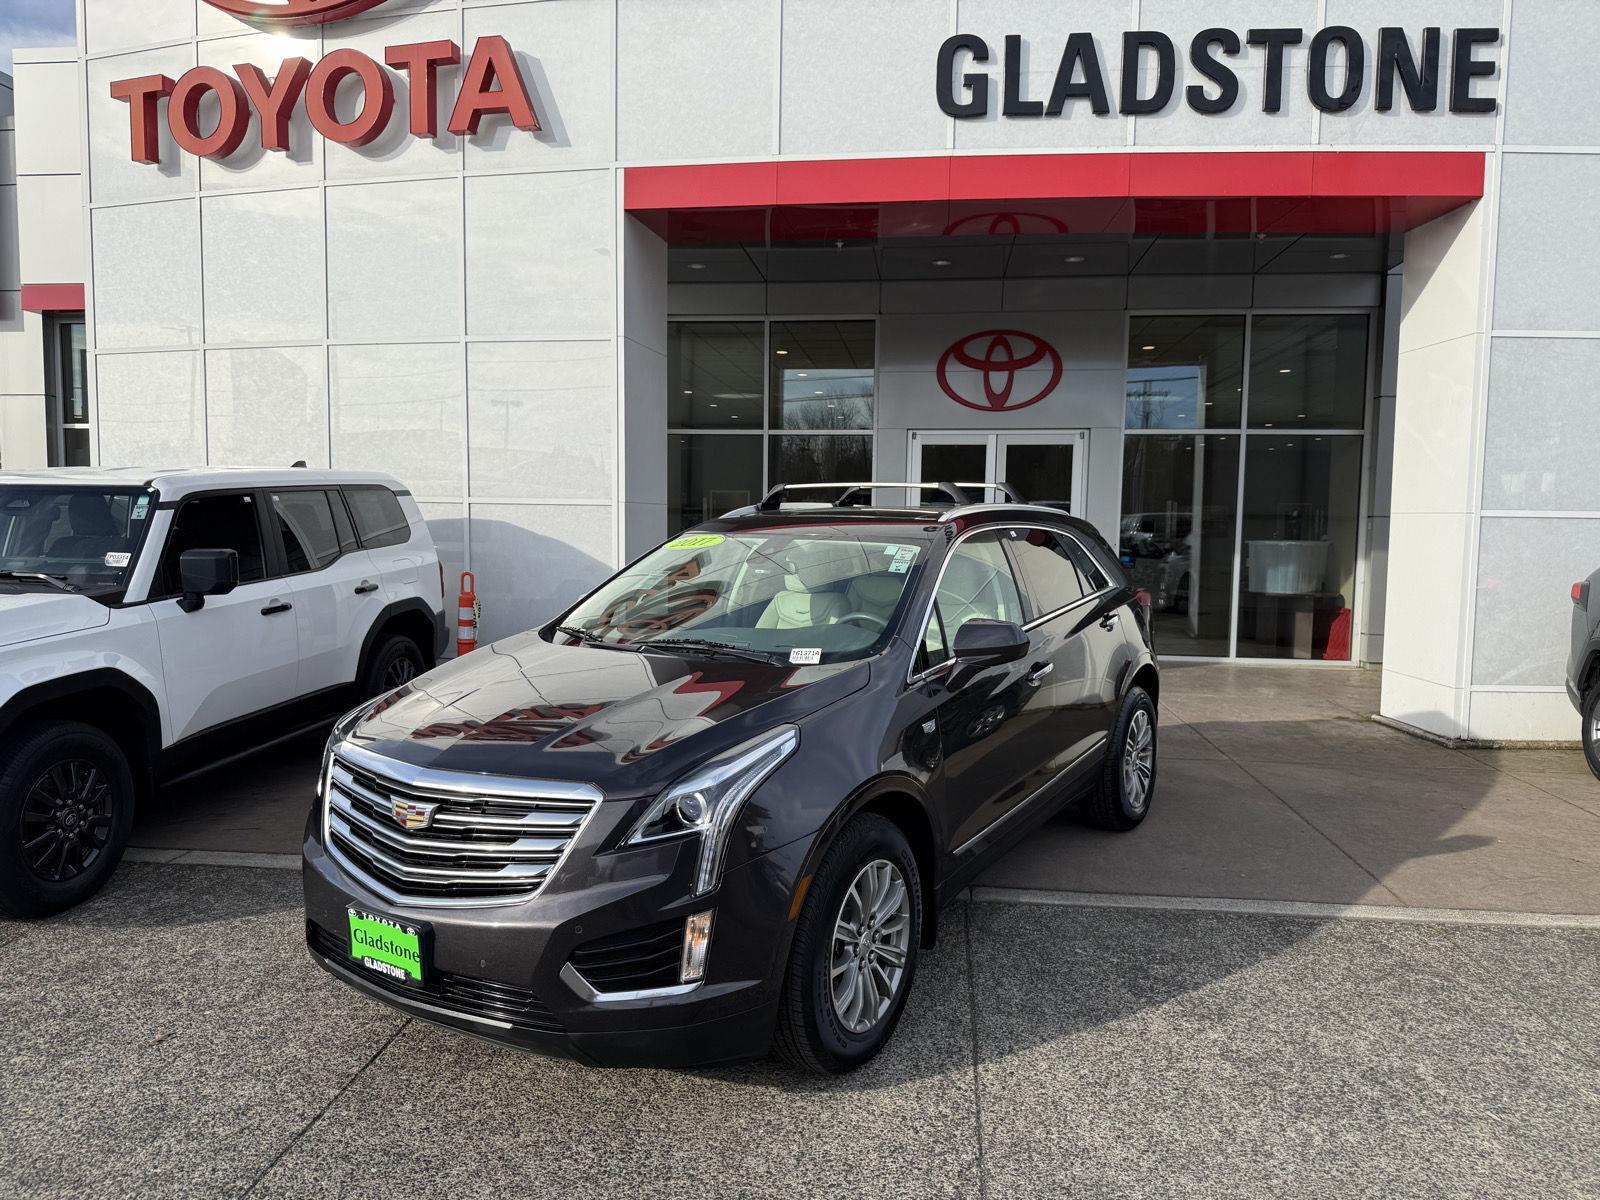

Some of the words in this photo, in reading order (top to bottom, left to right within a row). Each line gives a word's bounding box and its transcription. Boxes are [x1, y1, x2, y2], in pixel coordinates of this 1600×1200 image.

[936, 25, 1499, 118] GLADSTONE
[110, 35, 541, 165] TOYOTA
[362, 912, 401, 930] TOYOTA
[353, 928, 420, 963] Gladstone
[364, 956, 406, 980] GLADSTONE
